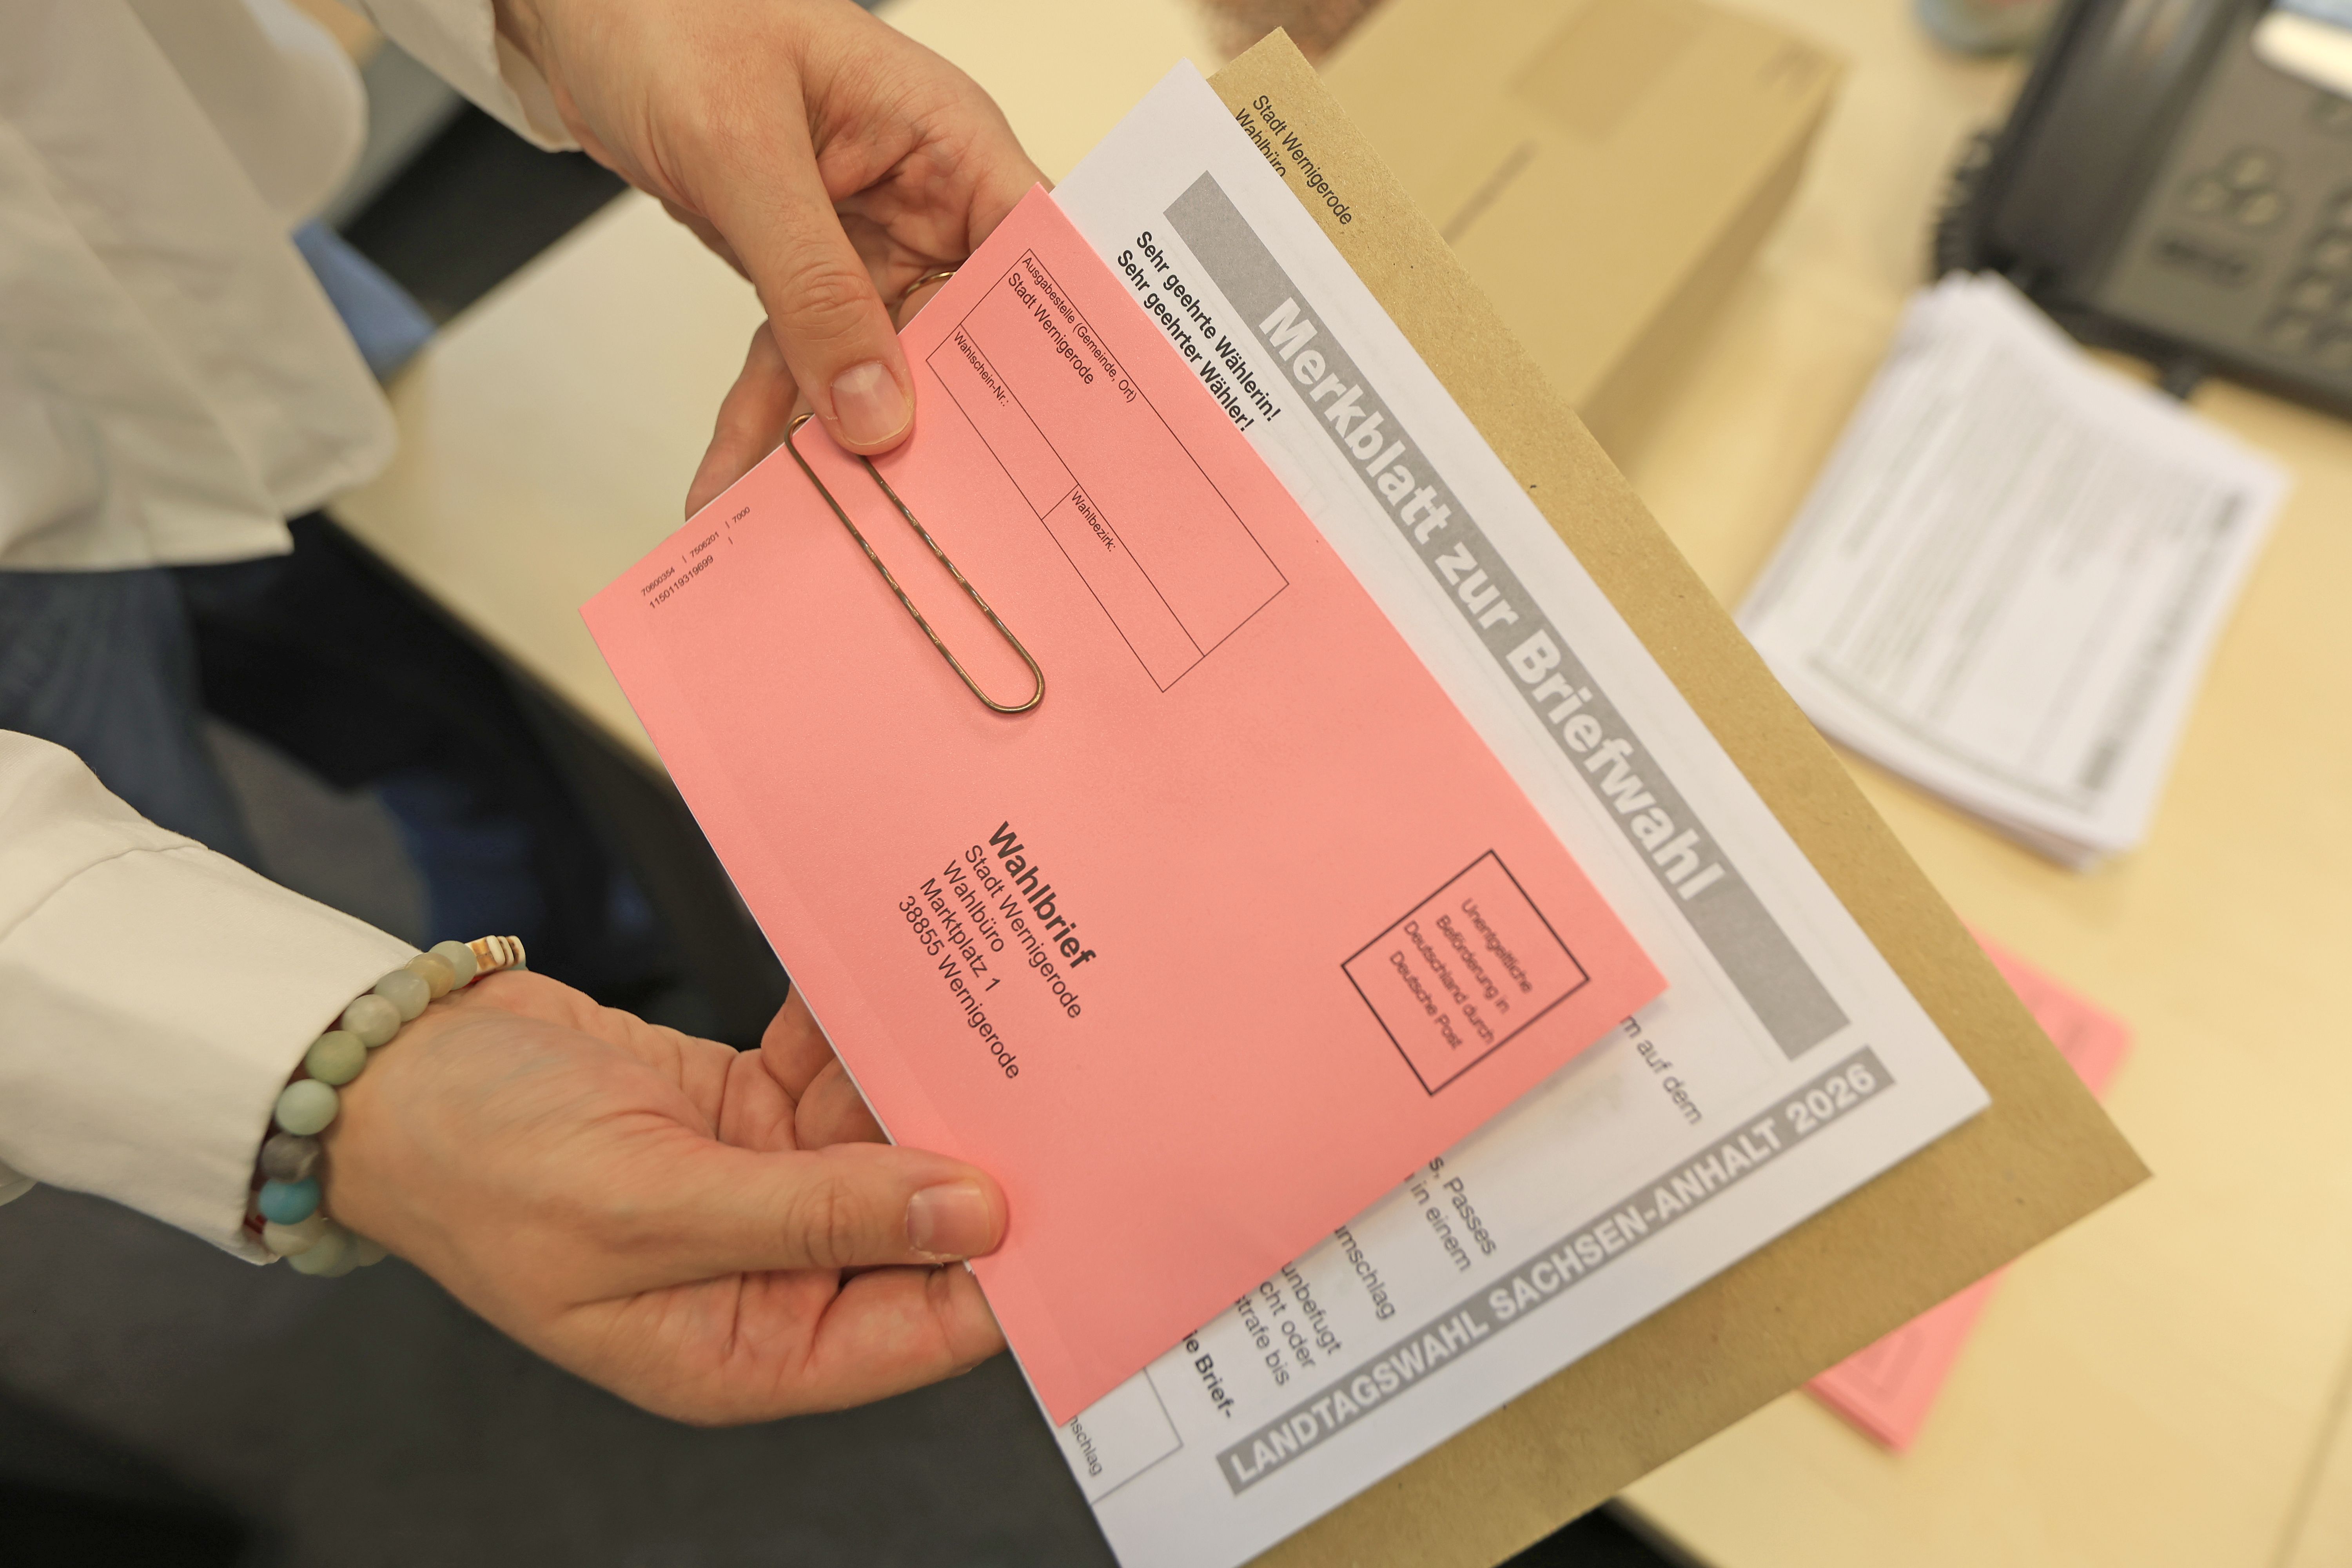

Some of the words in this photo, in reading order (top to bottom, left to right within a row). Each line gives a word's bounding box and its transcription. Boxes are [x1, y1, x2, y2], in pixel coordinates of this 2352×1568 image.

[1235, 108, 1286, 178] Wahlbüro
[1253, 95, 1287, 136] Stadt
[1282, 132, 1352, 225] Wernigerode
[954, 332, 1009, 407] Wahlschein-Nr.:
[1008, 273, 1037, 307] Stadt
[1033, 303, 1094, 385] Wernigerode
[1022, 256, 1075, 323] Ausgabestelle
[1073, 322, 1117, 381] (Gemeinde,
[1118, 379, 1137, 403] Ort)
[1118, 250, 1150, 288] Sehr
[1144, 290, 1202, 362] geehrter
[1200, 359, 1254, 432] Wähler!
[1137, 231, 1169, 271] Sehr
[1163, 272, 1216, 339] geehrte
[1214, 336, 1281, 421] Wählerin!
[732, 506, 750, 524] 7000
[1071, 491, 1116, 552] Wahlbezirk:
[1259, 297, 1451, 545] Merkblatt
[1434, 543, 1519, 630] zur
[1507, 629, 1727, 901] Briefwahl
[920, 878, 987, 978] Marktplatz
[985, 978, 1000, 991] 1
[943, 860, 1004, 953] Wahlbüro
[965, 845, 1005, 898] Stadt
[999, 895, 1081, 1018] Wernigerode
[989, 821, 1096, 968] Wahlbrief
[899, 896, 944, 956] 38855
[938, 955, 1019, 1079] Wernigerode
[1404, 920, 1468, 1004] Deutschland
[1463, 1003, 1495, 1044] durch
[1436, 915, 1499, 1000] Beförderung
[1496, 995, 1510, 1014] in
[1461, 897, 1532, 993] Unentgeltliche
[1390, 951, 1438, 1016] Deutsche
[1434, 1014, 1463, 1050] Post
[1637, 1038, 1674, 1074] auf
[1662, 1075, 1703, 1125] dem
[1411, 1181, 1431, 1206] in
[1426, 1205, 1472, 1273] einem
[1443, 1177, 1497, 1257] Passes
[1230, 1310, 1490, 1484] LANDTAGSWAHL
[1488, 1120, 1782, 1322] SACHSEN-ANHALT
[1785, 1063, 1877, 1134] 2026
[1281, 1261, 1342, 1355] unbefugt
[1195, 1354, 1234, 1418] Brief-
[1265, 1349, 1290, 1386] bis
[1282, 1320, 1316, 1369] oder
